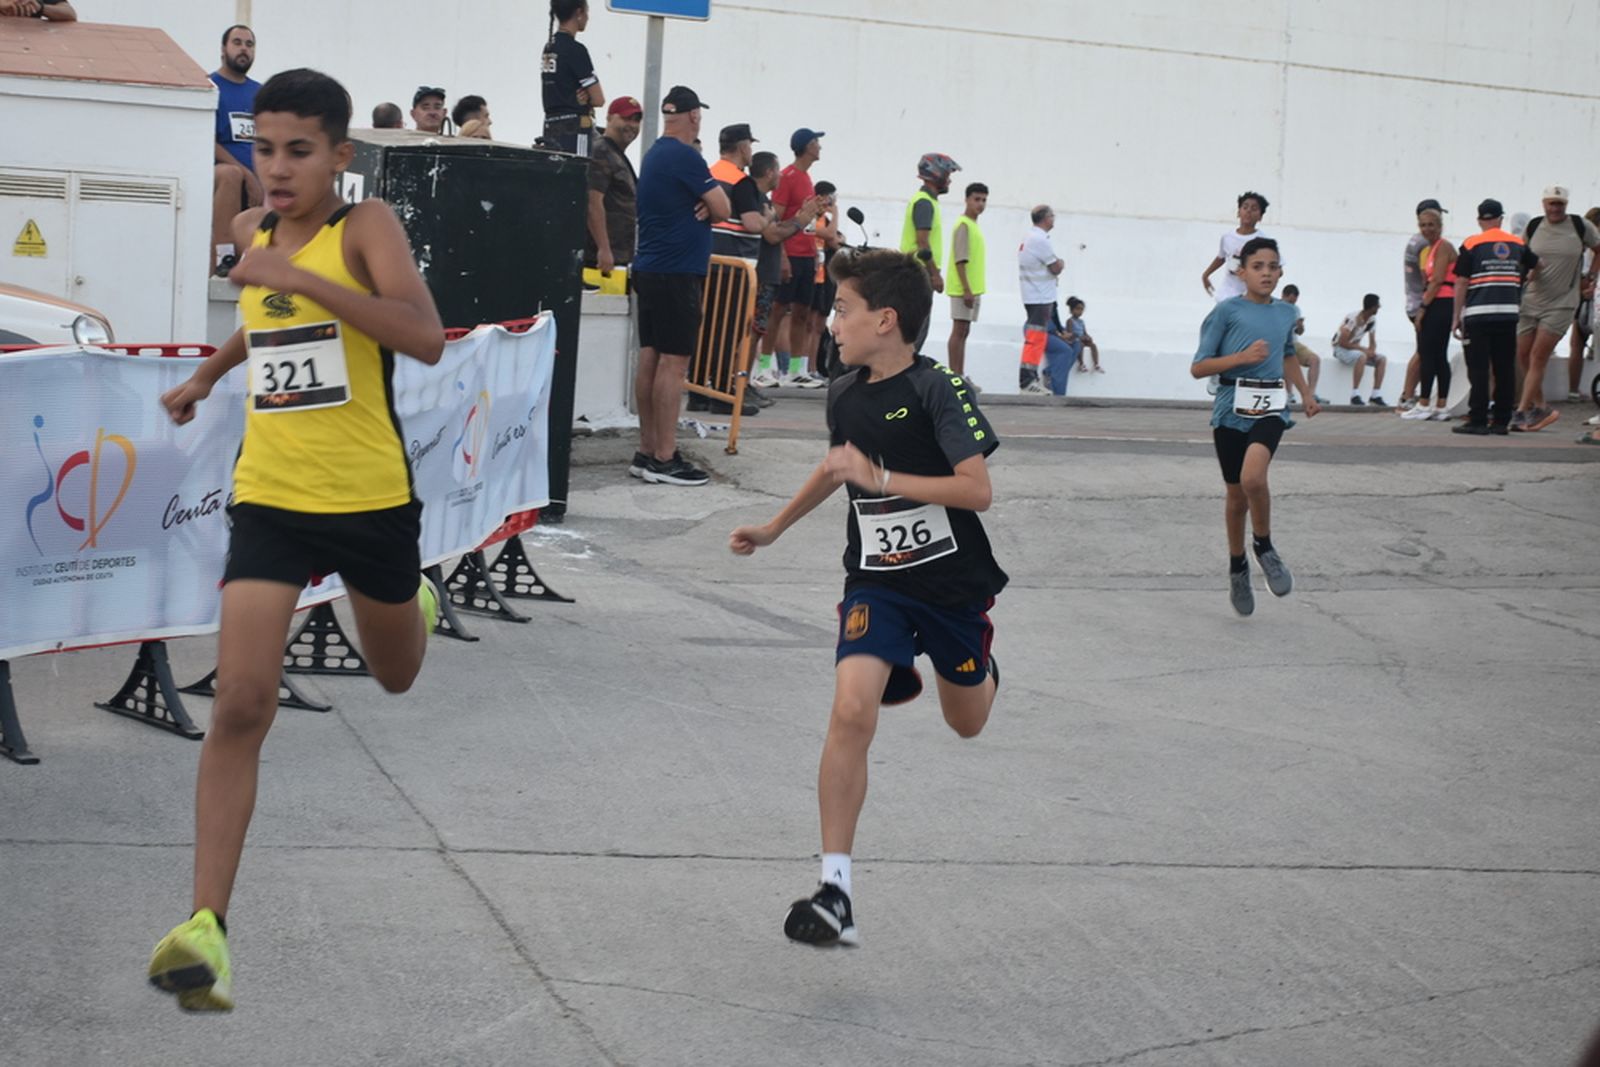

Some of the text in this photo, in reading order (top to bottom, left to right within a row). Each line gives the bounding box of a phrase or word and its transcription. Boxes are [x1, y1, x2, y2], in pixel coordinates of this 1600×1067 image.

[262, 357, 324, 393] 321
[1252, 394, 1271, 411] 75
[162, 488, 222, 530] Ceuta
[875, 519, 932, 553] 326
[91, 556, 137, 571] DEPORTES
